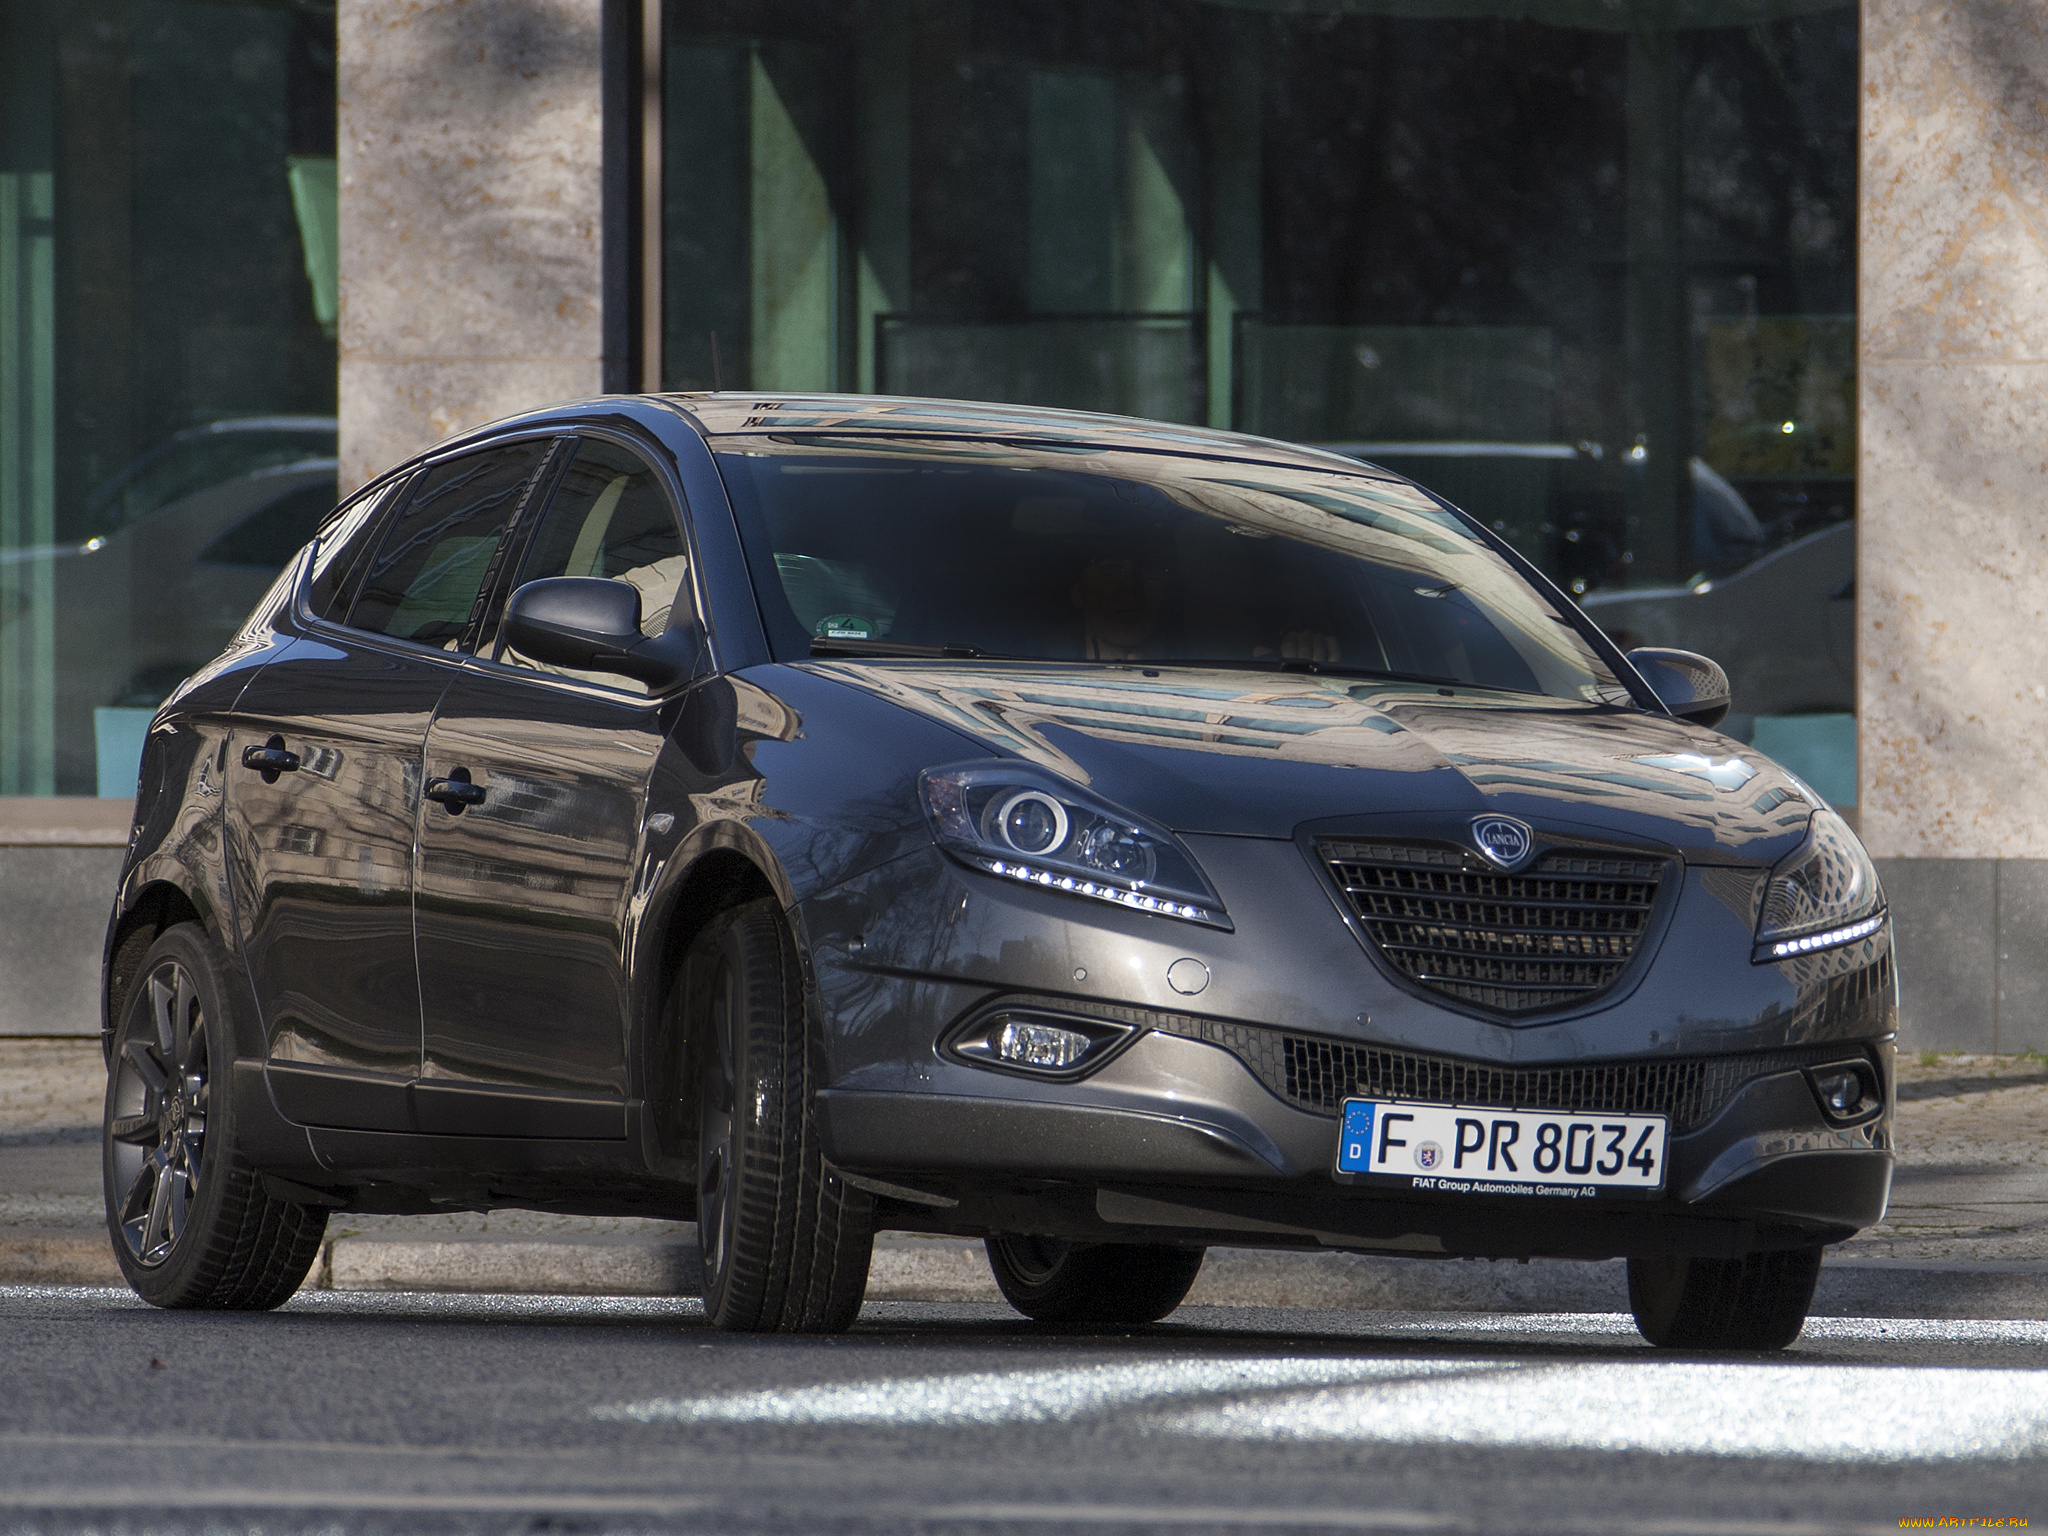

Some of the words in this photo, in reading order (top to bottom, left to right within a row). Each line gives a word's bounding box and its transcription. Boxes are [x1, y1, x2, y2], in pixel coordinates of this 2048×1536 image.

[1486, 833, 1520, 846] LANCIA
[1349, 1144, 1361, 1159] D
[1377, 1113, 1414, 1164] F
[1453, 1118, 1520, 1172] PR
[1533, 1122, 1655, 1177] 8034
[1412, 1177, 1436, 1189] FIAT
[1438, 1179, 1470, 1192] Group
[1472, 1181, 1534, 1195] Automobiles
[1536, 1184, 1579, 1199] Germany
[1580, 1186, 1595, 1197] AG
